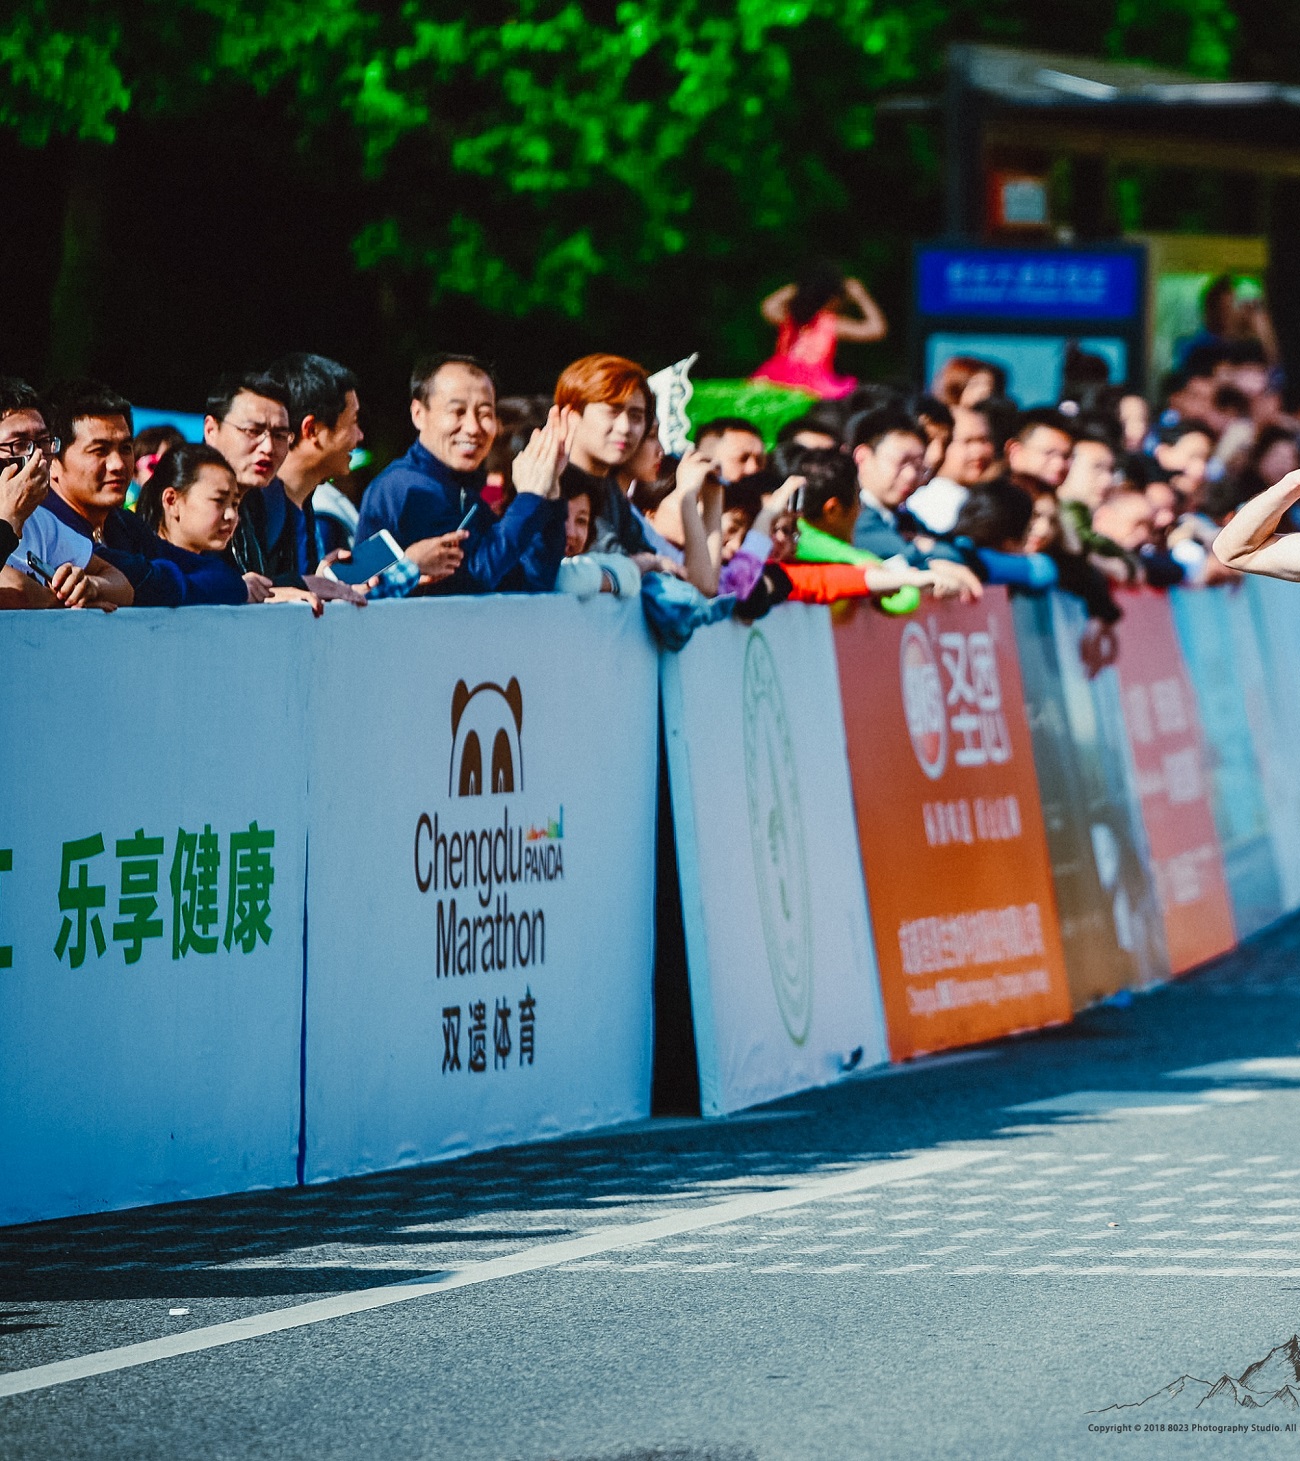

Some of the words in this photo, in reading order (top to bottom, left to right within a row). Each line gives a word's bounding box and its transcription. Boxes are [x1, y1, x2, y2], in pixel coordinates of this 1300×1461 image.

[53, 820, 275, 969] 乐享健康
[414, 805, 523, 907] Chengdu
[523, 844, 564, 883] PANDA
[435, 891, 545, 978] Marathon
[441, 984, 536, 1075] 双遗体育
